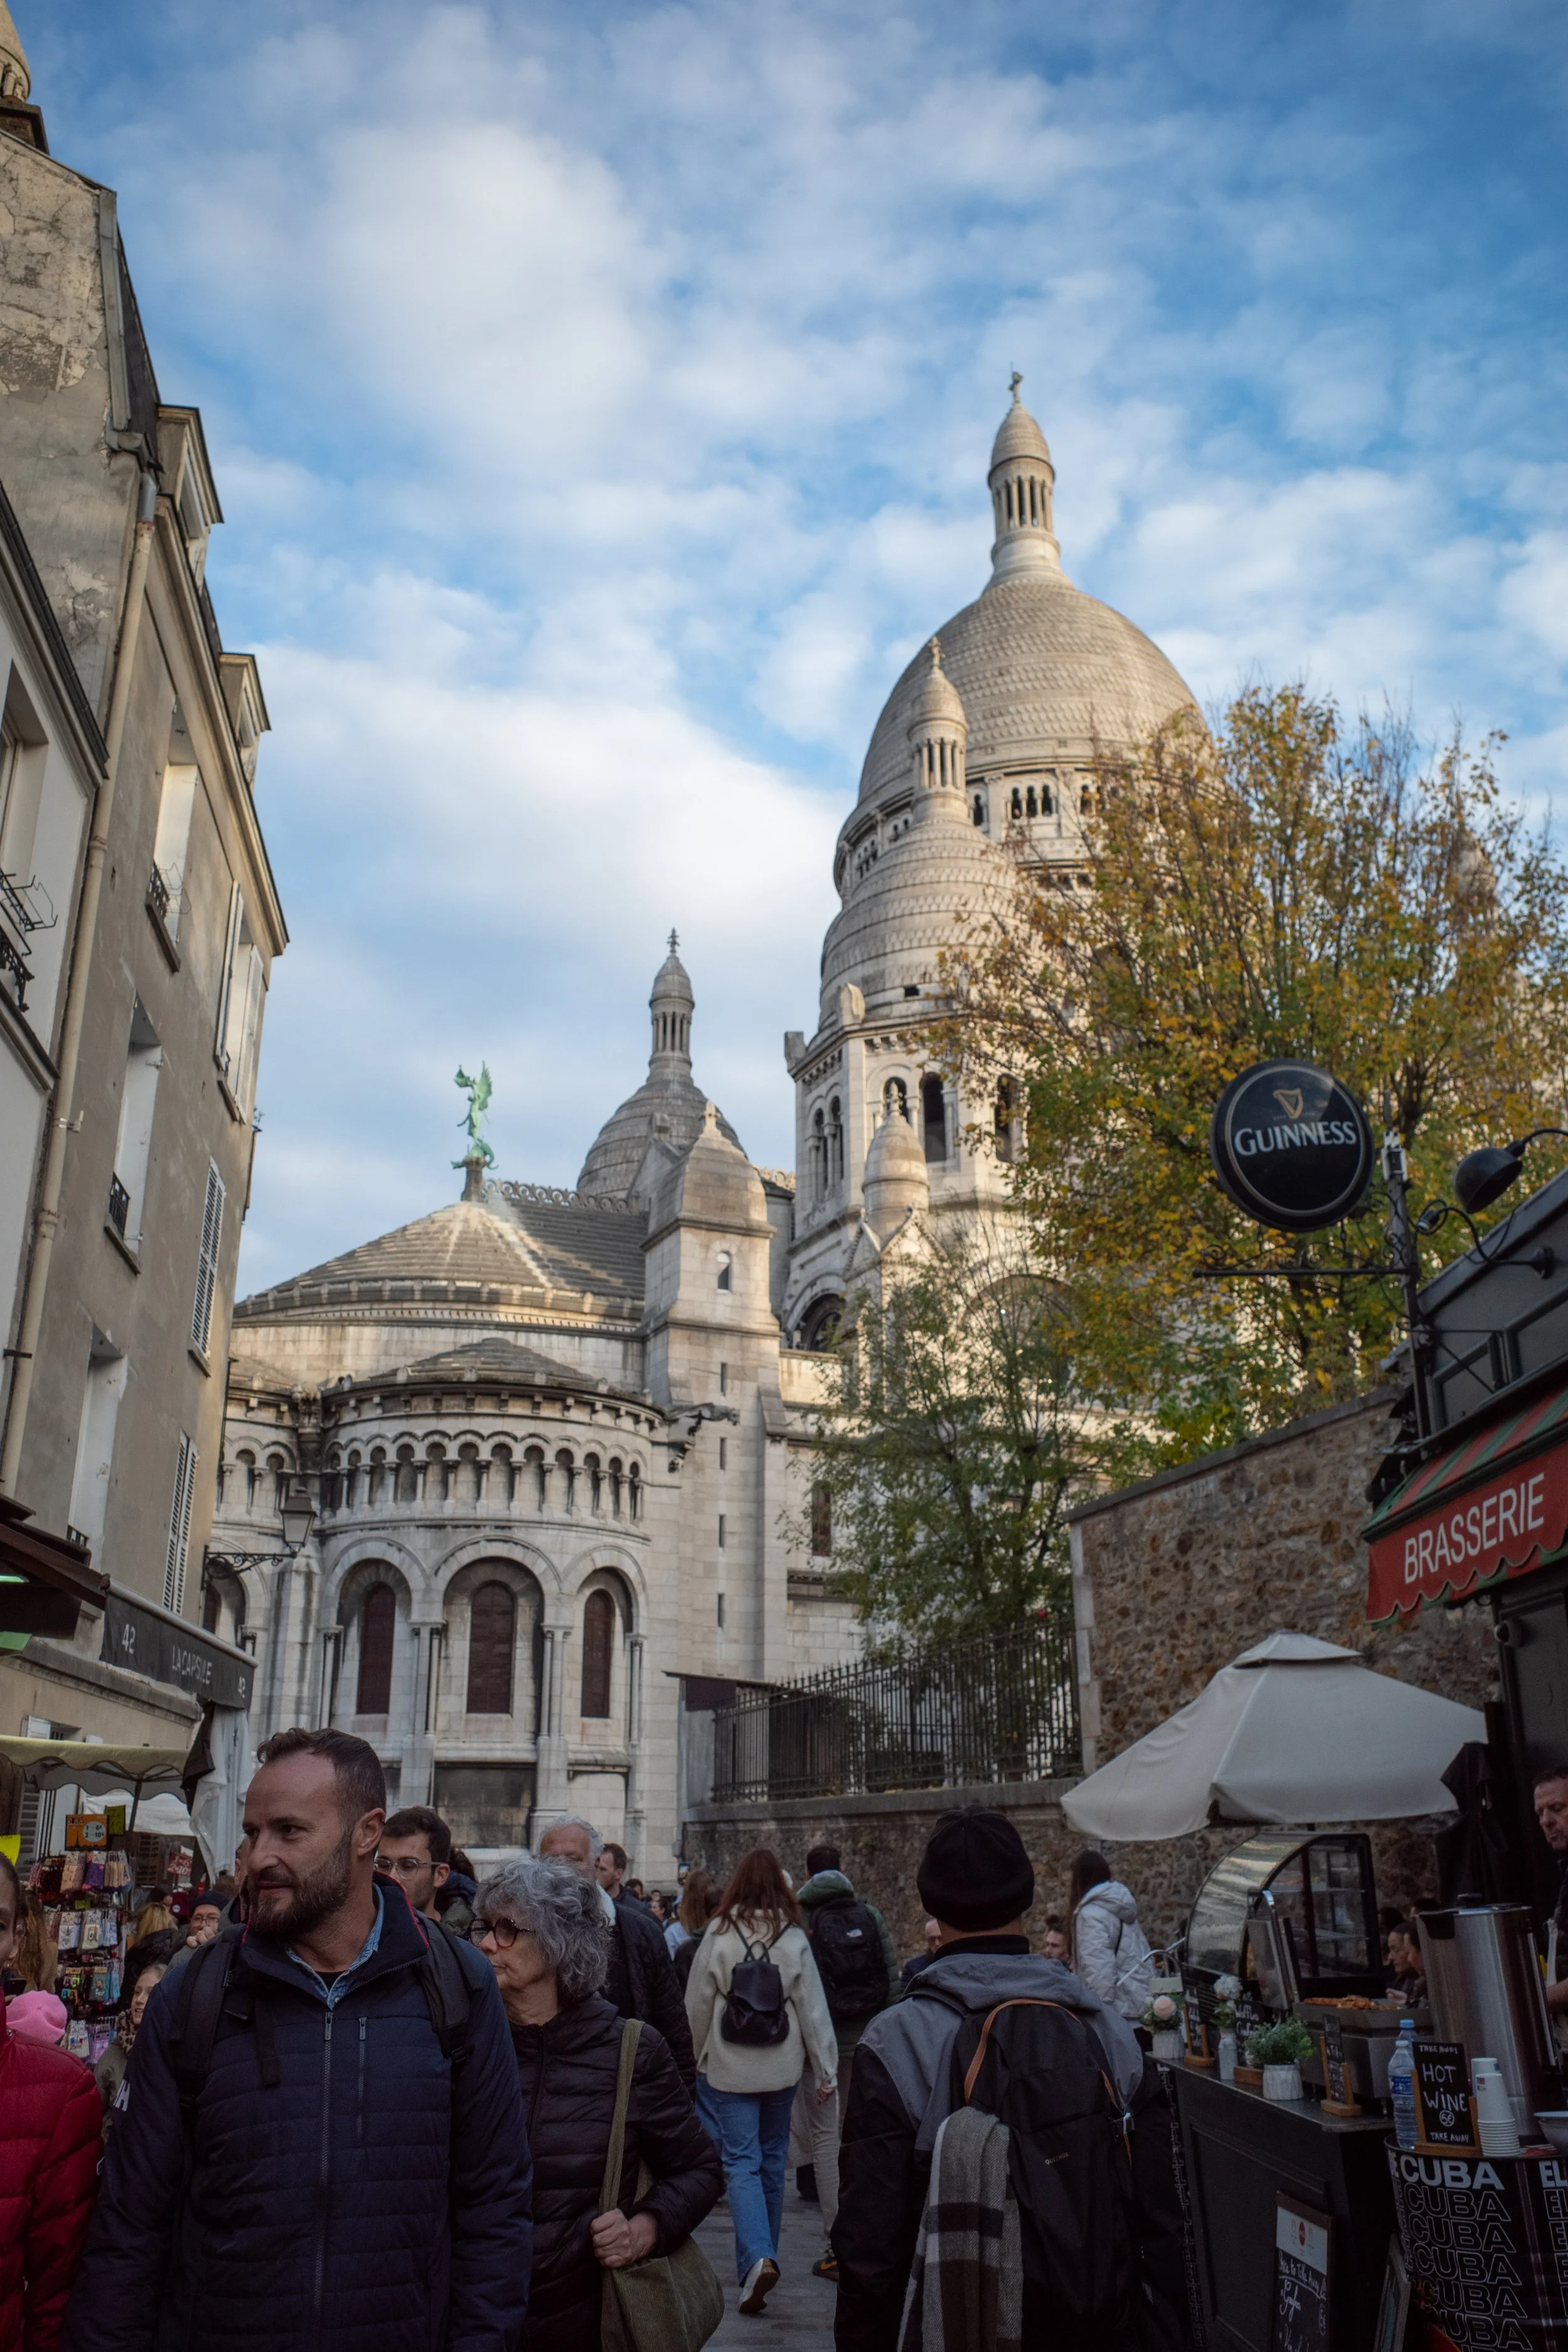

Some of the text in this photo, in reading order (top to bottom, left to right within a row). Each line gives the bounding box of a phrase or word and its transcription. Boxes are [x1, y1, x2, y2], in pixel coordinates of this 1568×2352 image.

[1234, 1121, 1357, 1156] GUINNESS
[1404, 1472, 1545, 1584] BRASSERIE
[122, 1624, 135, 1654] 42
[1422, 2063, 1456, 2084] HOT
[1429, 2131, 1470, 2143] TAKE AWAY
[1400, 2154, 1505, 2190] CUBA
[1404, 2182, 1512, 2222] CUBA
[1408, 2212, 1517, 2254] CUBA
[1413, 2242, 1522, 2286] CUBA
[1434, 2306, 1534, 2351] UBA
